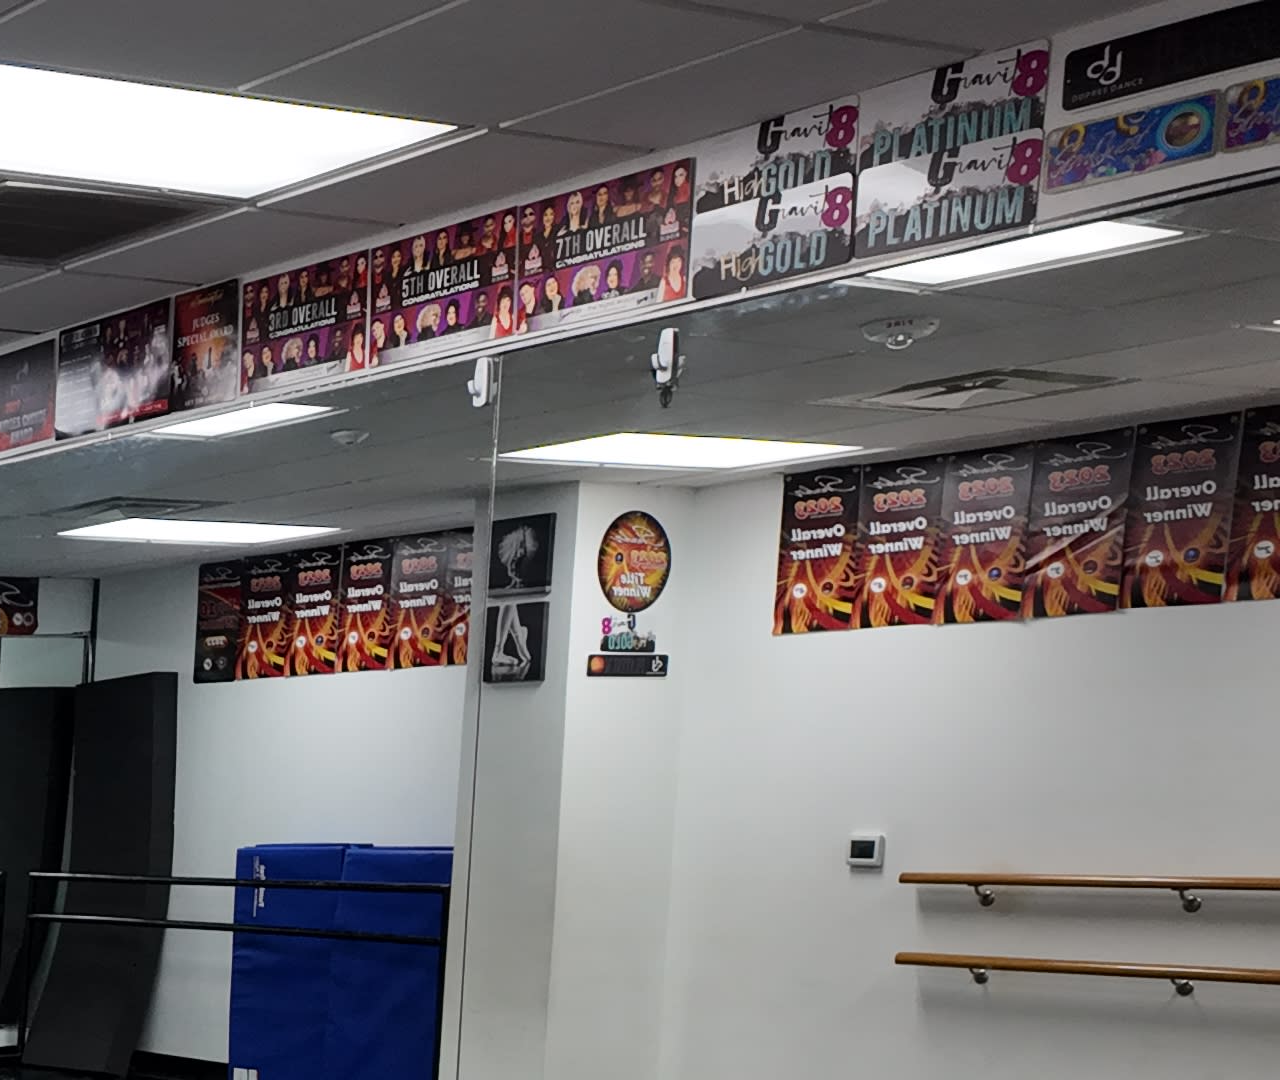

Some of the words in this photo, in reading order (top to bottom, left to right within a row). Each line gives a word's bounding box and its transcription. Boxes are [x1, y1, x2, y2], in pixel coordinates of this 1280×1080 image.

[873, 96, 1032, 167] PLATINUM
[760, 151, 832, 197] GOLD
[556, 231, 582, 260] 7TH
[585, 216, 647, 252] OVERALL
[868, 186, 1026, 248] PLATINUM
[758, 231, 827, 276] GOLD
[402, 273, 424, 299] 5TH
[427, 259, 481, 291] OVERALL
[268, 309, 290, 331] 3RD
[292, 297, 338, 325] OVERALL
